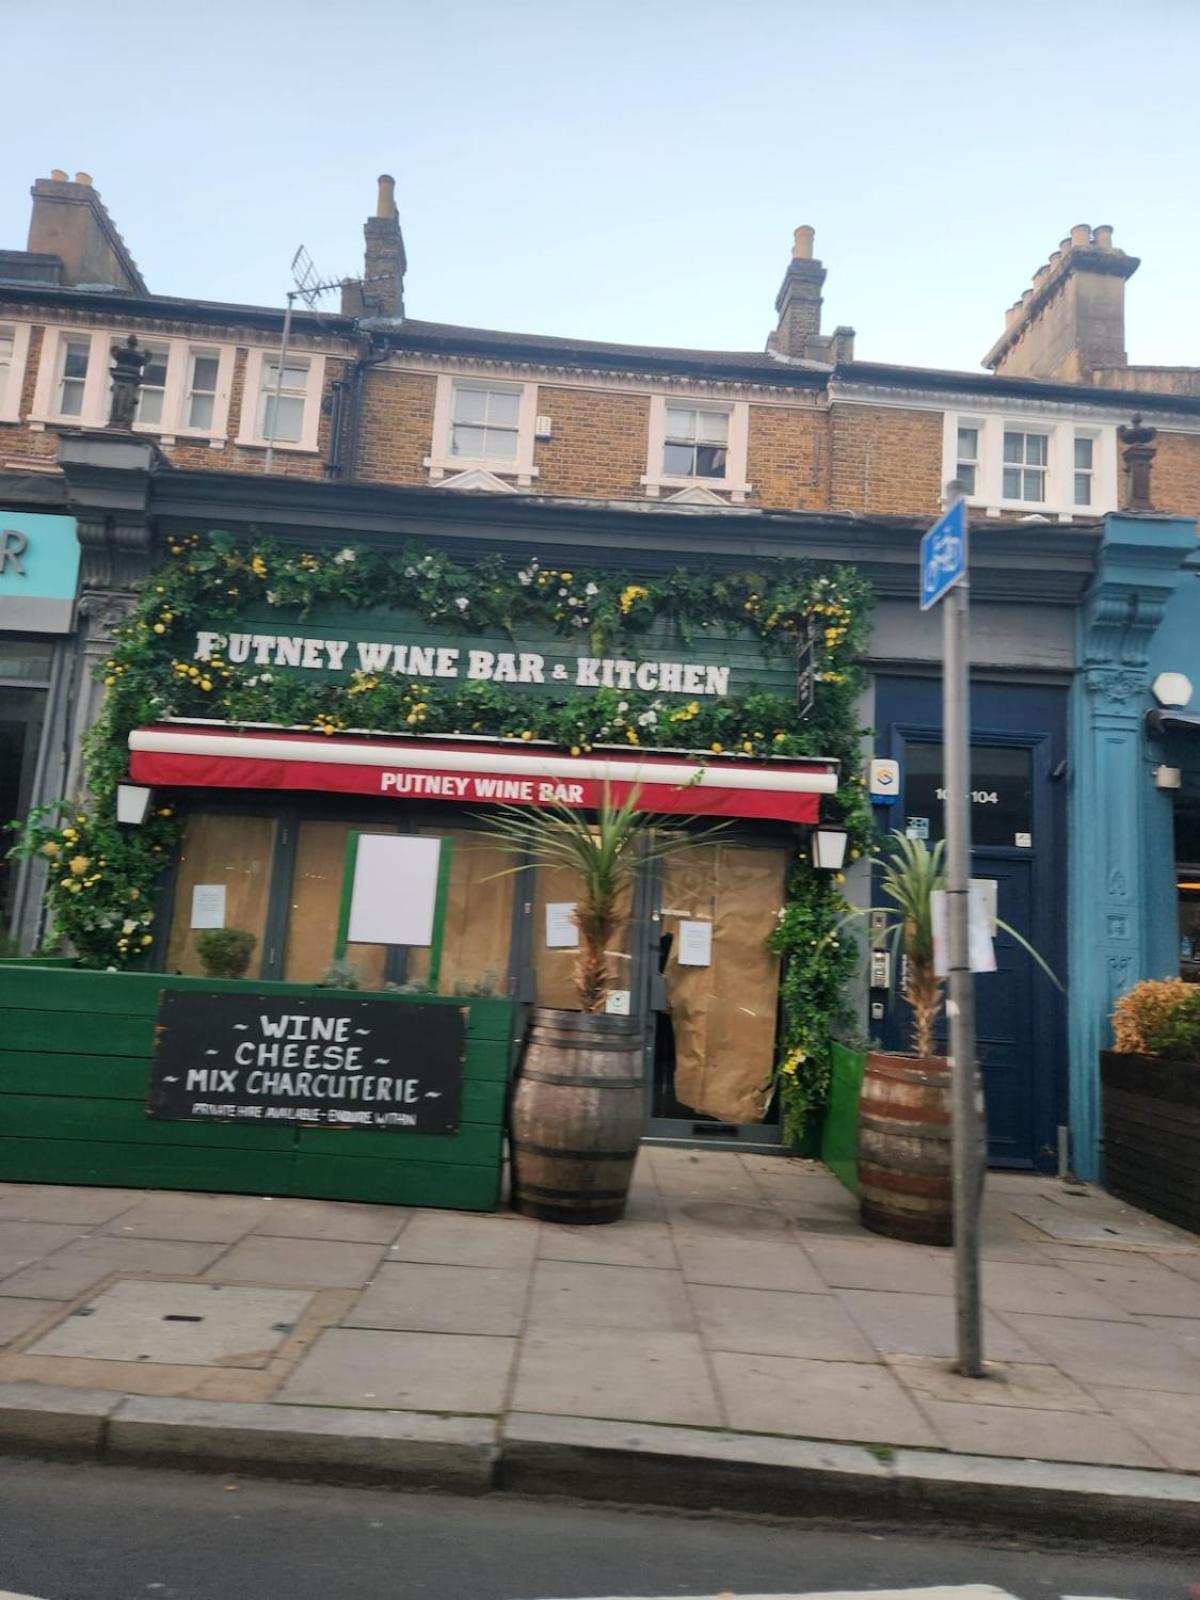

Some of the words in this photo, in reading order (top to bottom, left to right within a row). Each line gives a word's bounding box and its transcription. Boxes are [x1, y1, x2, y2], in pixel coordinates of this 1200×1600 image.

[194, 631, 349, 670] PUTNEY
[356, 642, 459, 678] WINE
[467, 650, 545, 683] BAR
[552, 664, 569, 680] &
[576, 657, 731, 696] KITCHEN
[381, 772, 470, 797] PUTNEY
[474, 777, 533, 800] WINE
[538, 782, 584, 803] BAR
[260, 1014, 352, 1043] WINE
[233, 1042, 364, 1071] CHEESE
[185, 1068, 239, 1093] MIX
[246, 1070, 420, 1104] CHARCUTERIE
